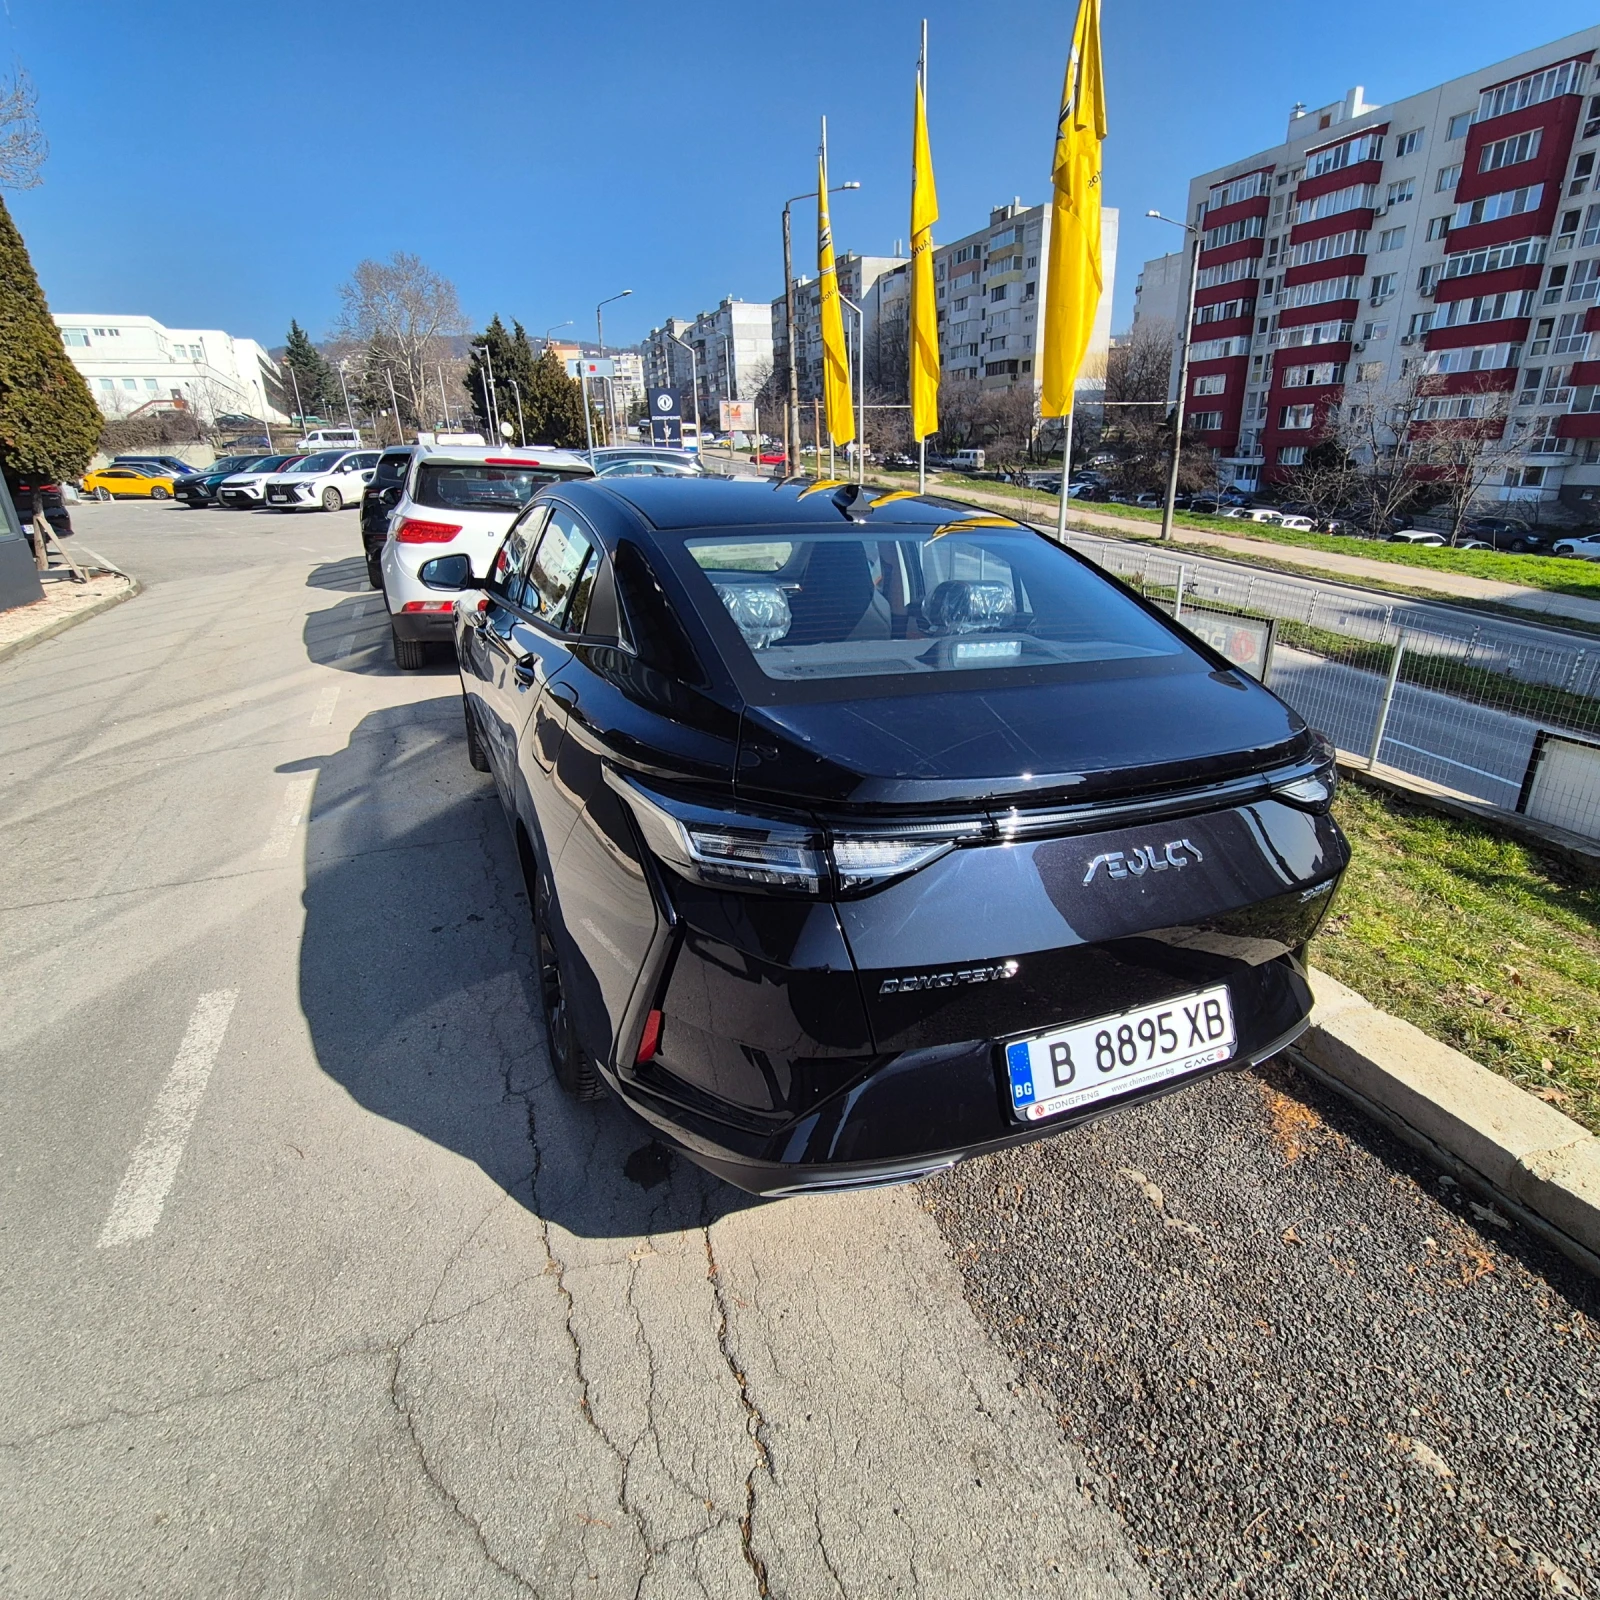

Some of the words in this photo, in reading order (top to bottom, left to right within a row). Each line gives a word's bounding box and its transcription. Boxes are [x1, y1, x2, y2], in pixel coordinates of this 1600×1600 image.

[1049, 1041, 1076, 1088] B
[1095, 1011, 1178, 1073] 8895
[1183, 998, 1225, 1047] XB
[1015, 1082, 1032, 1098] BG
[1048, 1090, 1100, 1112] DONGFENG
[1111, 1067, 1175, 1093] www.chinamotor.bg
